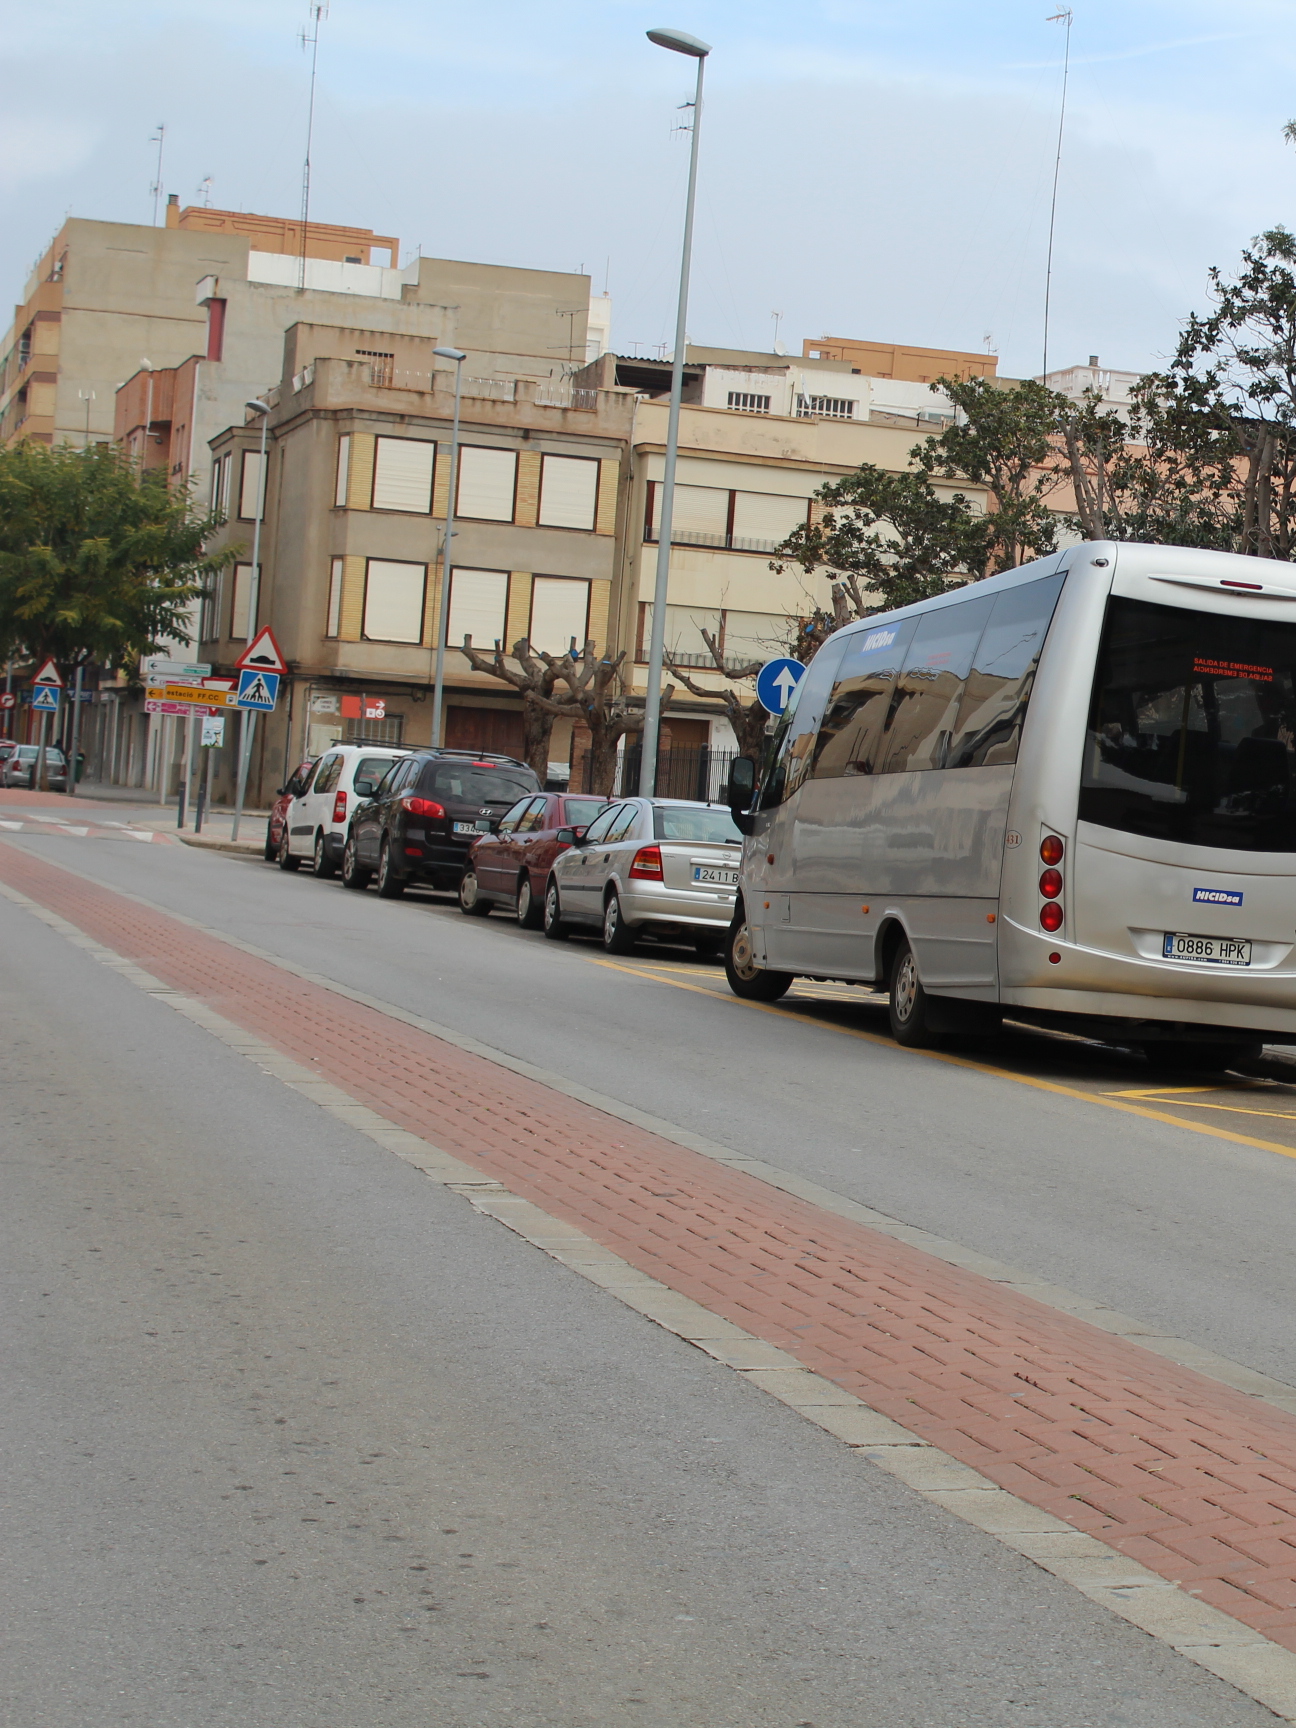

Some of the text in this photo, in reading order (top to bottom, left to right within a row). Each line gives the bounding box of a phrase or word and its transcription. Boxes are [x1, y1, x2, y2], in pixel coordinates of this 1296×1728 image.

[1194, 658, 1218, 666] SALIDA
[1230, 663, 1273, 673] EMERGENCIA
[167, 690, 193, 698] estació
[1006, 835, 1019, 844] 431
[702, 870, 729, 881] 2411
[1196, 890, 1240, 903] HICIDsa
[1177, 938, 1213, 956] 0886
[1219, 942, 1246, 960] HPK
